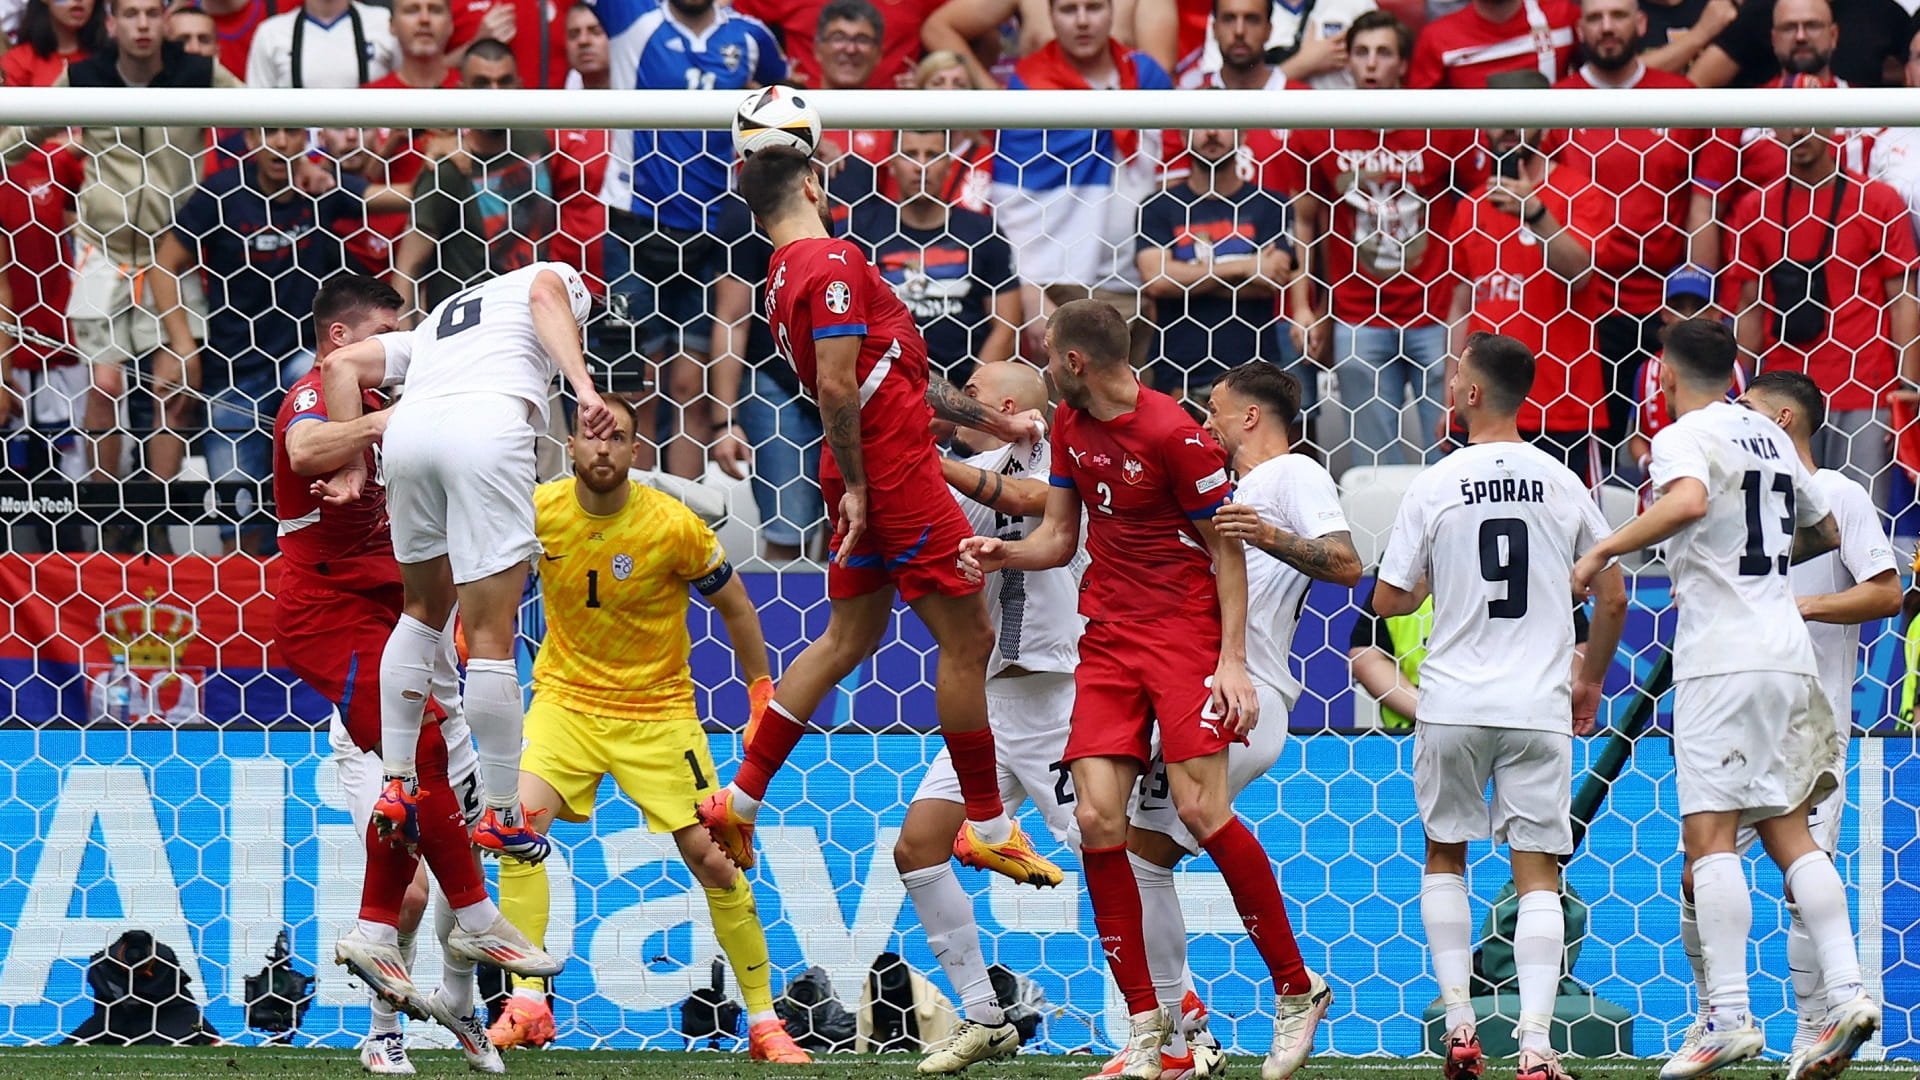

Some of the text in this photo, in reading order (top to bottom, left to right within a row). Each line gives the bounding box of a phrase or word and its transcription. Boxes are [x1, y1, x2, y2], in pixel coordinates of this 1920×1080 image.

[436, 284, 483, 341] 6
[1097, 481, 1113, 515] 2
[1460, 478, 1544, 505] ŠPORAR
[1739, 470, 1795, 576] 13
[586, 569, 600, 608] 1
[1479, 517, 1529, 619] 9
[684, 749, 709, 791] 1
